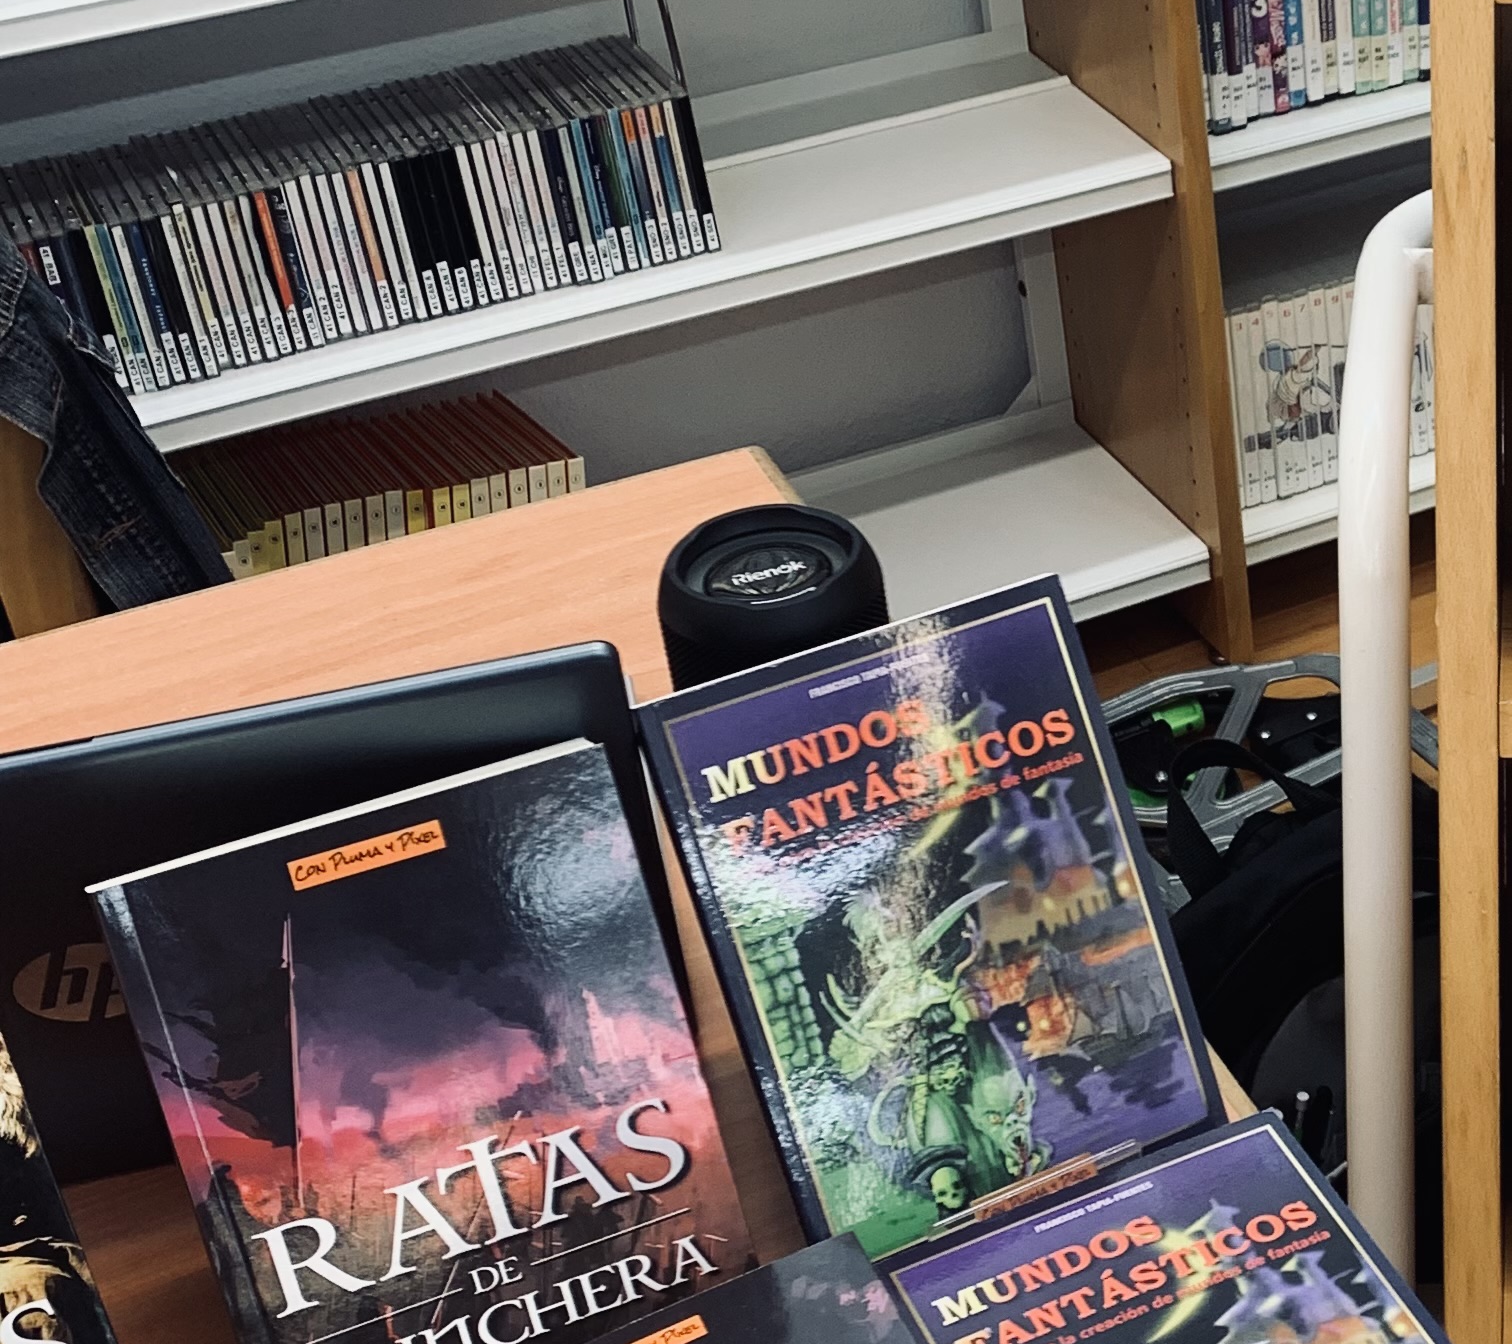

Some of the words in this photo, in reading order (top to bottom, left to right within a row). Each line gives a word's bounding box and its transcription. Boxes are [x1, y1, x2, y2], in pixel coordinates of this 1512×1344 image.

[700, 700, 931, 805] MUNDOS
[722, 707, 1077, 859] FANTÁSTICOS
[295, 862, 327, 882] CON
[251, 1097, 687, 1320] RATAS
[469, 1257, 523, 1296] DE
[931, 1214, 1165, 1328] MUNDOS
[1079, 1303, 1150, 1341] creación
[1152, 1292, 1174, 1310] de
[1244, 1254, 1266, 1272] de
